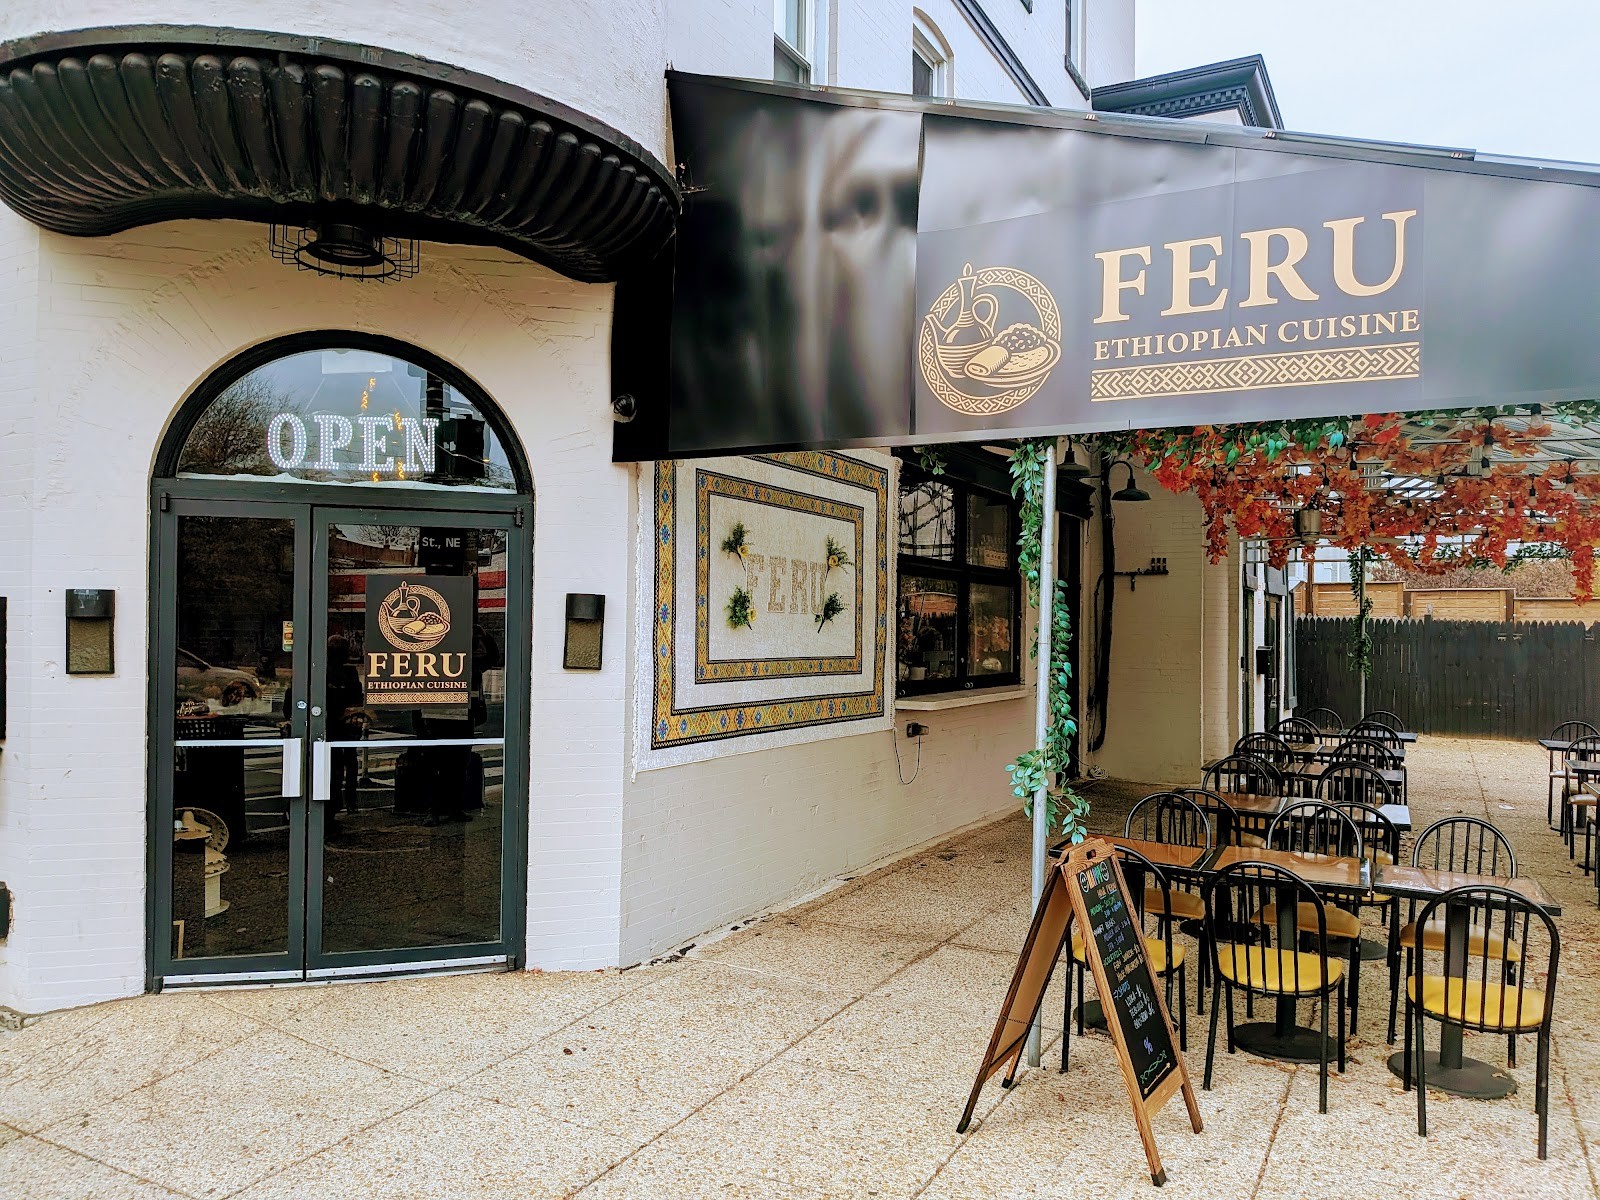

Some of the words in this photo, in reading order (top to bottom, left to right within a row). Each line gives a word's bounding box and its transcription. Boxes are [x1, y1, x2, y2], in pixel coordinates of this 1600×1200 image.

[1093, 208, 1417, 325] FERU
[1093, 323, 1269, 362] ETHIOPIAN
[1276, 309, 1421, 346] CUISINE
[267, 412, 440, 473] OPEN
[422, 536, 441, 549] St.,
[445, 537, 461, 548] NE
[747, 552, 827, 616] FERU
[366, 652, 467, 678] FERU
[367, 681, 425, 690] ETHIOPIAN
[426, 681, 468, 689] CUISINE
